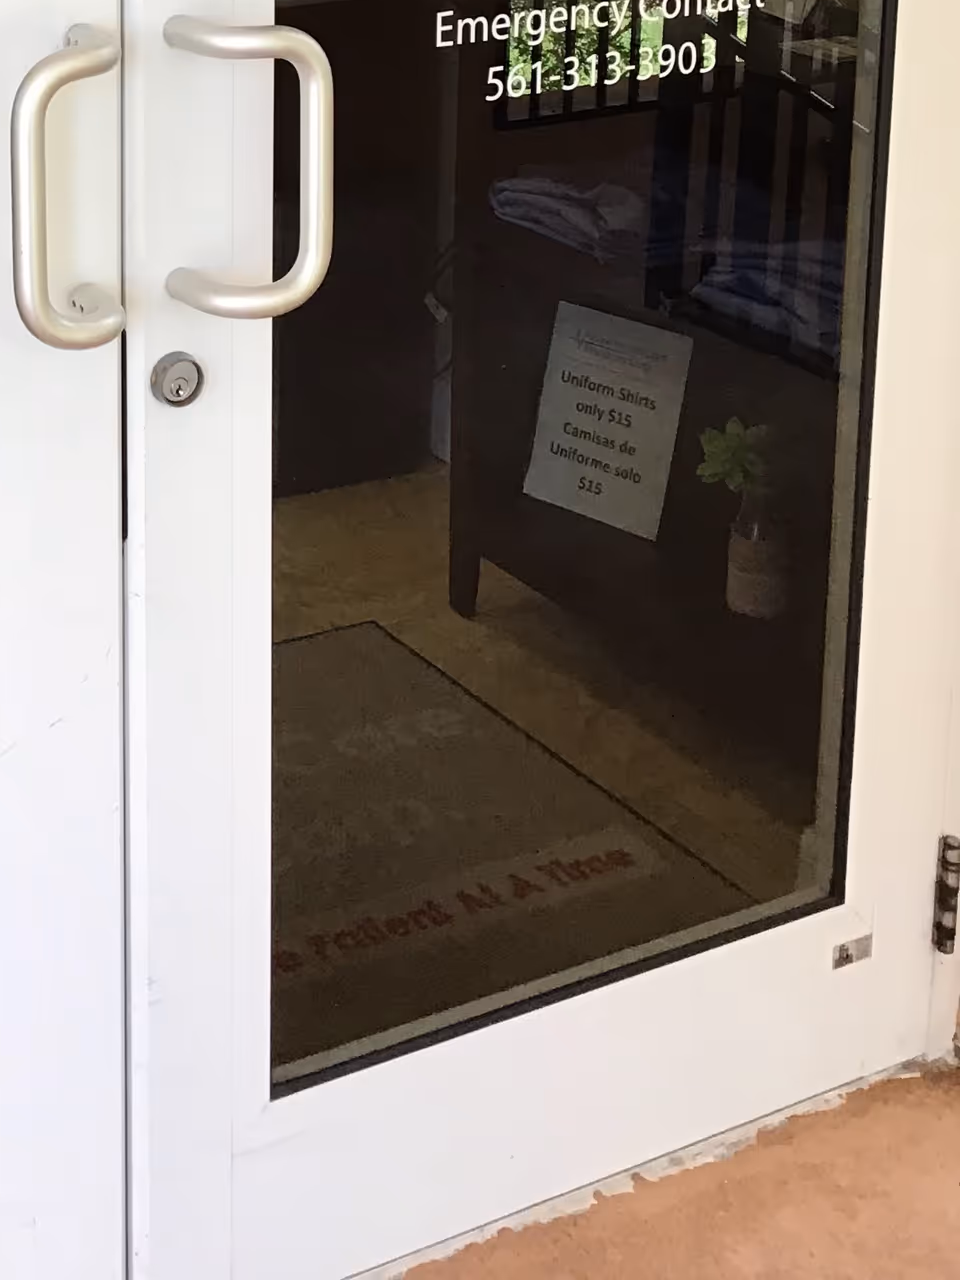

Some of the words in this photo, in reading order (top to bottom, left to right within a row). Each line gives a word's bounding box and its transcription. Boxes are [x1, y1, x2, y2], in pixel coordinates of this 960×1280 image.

[484, 36, 718, 102] 561-313-3903
[560, 369, 615, 398] Uniform
[618, 387, 657, 411] Shirts
[575, 401, 605, 421] only
[608, 408, 632, 428] $15
[563, 421, 616, 450] Camisas
[619, 440, 637, 456] de
[549, 440, 611, 474] Uniforme
[614, 466, 642, 484] solo
[577, 476, 603, 496] $15
